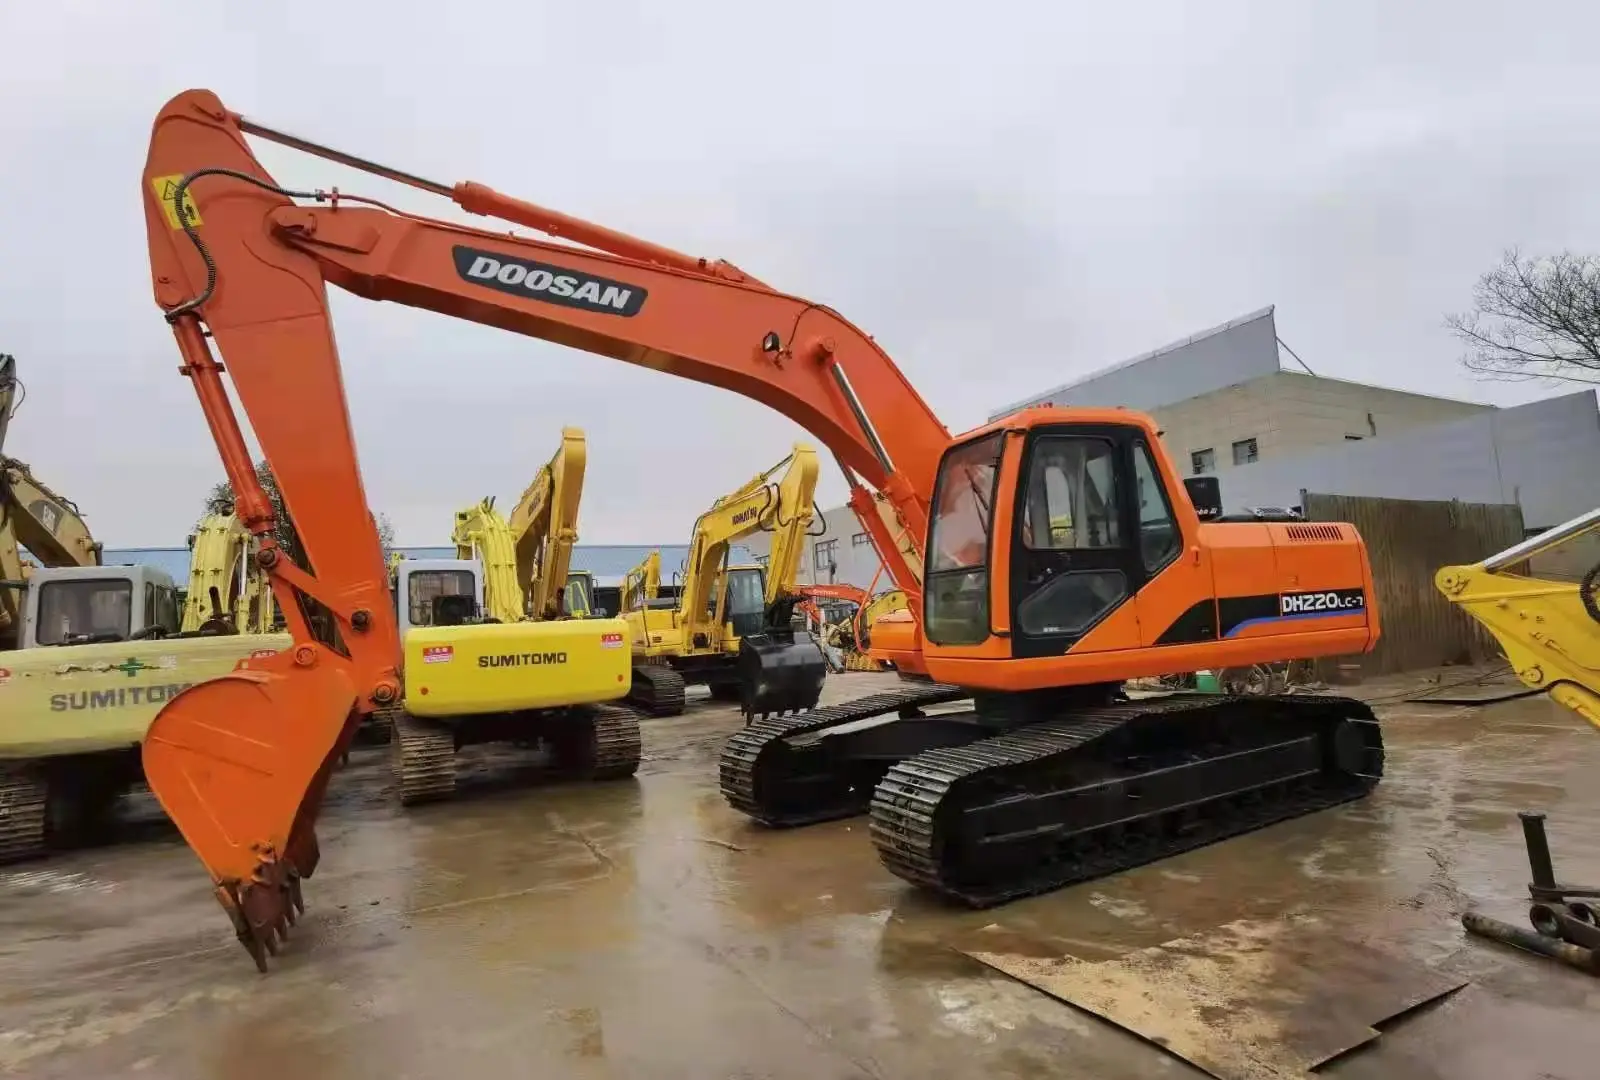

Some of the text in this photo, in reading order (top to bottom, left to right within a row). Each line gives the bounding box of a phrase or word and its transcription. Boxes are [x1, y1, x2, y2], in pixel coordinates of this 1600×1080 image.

[467, 256, 631, 310] DOOSAN
[478, 652, 568, 668] SUMITOMO
[50, 682, 193, 712] SUMITOM
